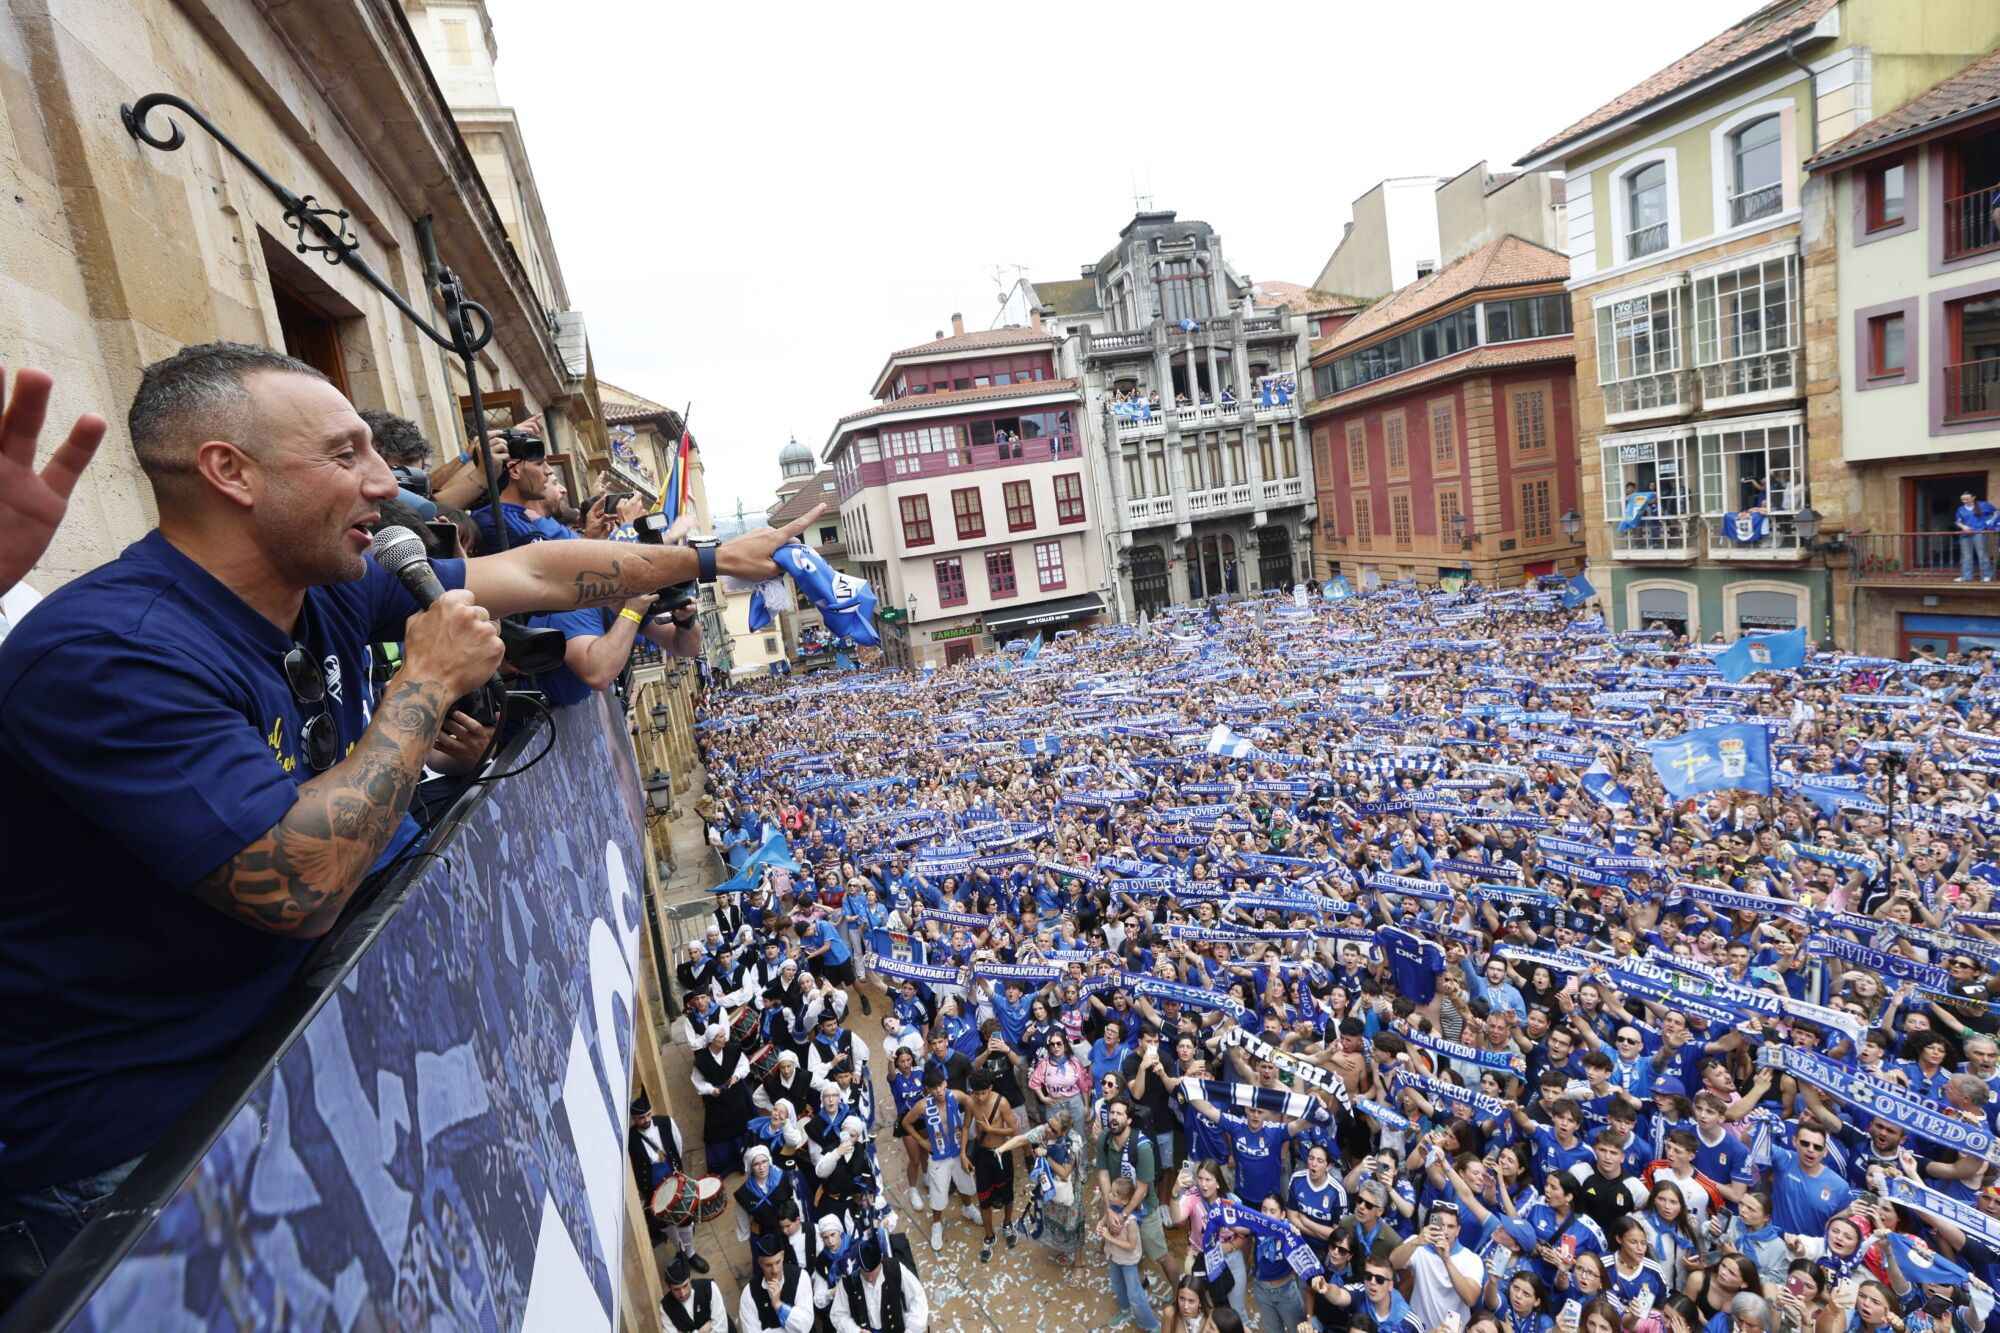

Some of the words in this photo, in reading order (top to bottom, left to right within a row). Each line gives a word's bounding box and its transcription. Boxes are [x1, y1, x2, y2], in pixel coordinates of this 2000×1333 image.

[932, 625, 982, 640] FARMACIA
[1195, 806, 1227, 816] OVIEDO
[1366, 801, 1412, 812] OVIEDO
[1174, 836, 1208, 845] OVIEDO
[1131, 879, 1171, 890] OVIEDO
[1283, 888, 1307, 901] Real
[1308, 895, 1350, 912] OVIEDO
[1719, 894, 1777, 912] OVIEDO
[879, 959, 956, 979] INQUEBRANTABLES
[975, 966, 1060, 977] INQUEBRANTABLES
[1410, 1030, 1434, 1047] Real
[1436, 1038, 1477, 1059] OVIEDO
[1480, 1051, 1508, 1067] 1926
[1427, 1077, 1472, 1103] OVIEDO
[1473, 1092, 1503, 1117] 1926
[1785, 1048, 1847, 1094] REAL
[1874, 1096, 1989, 1150] OVIEDO
